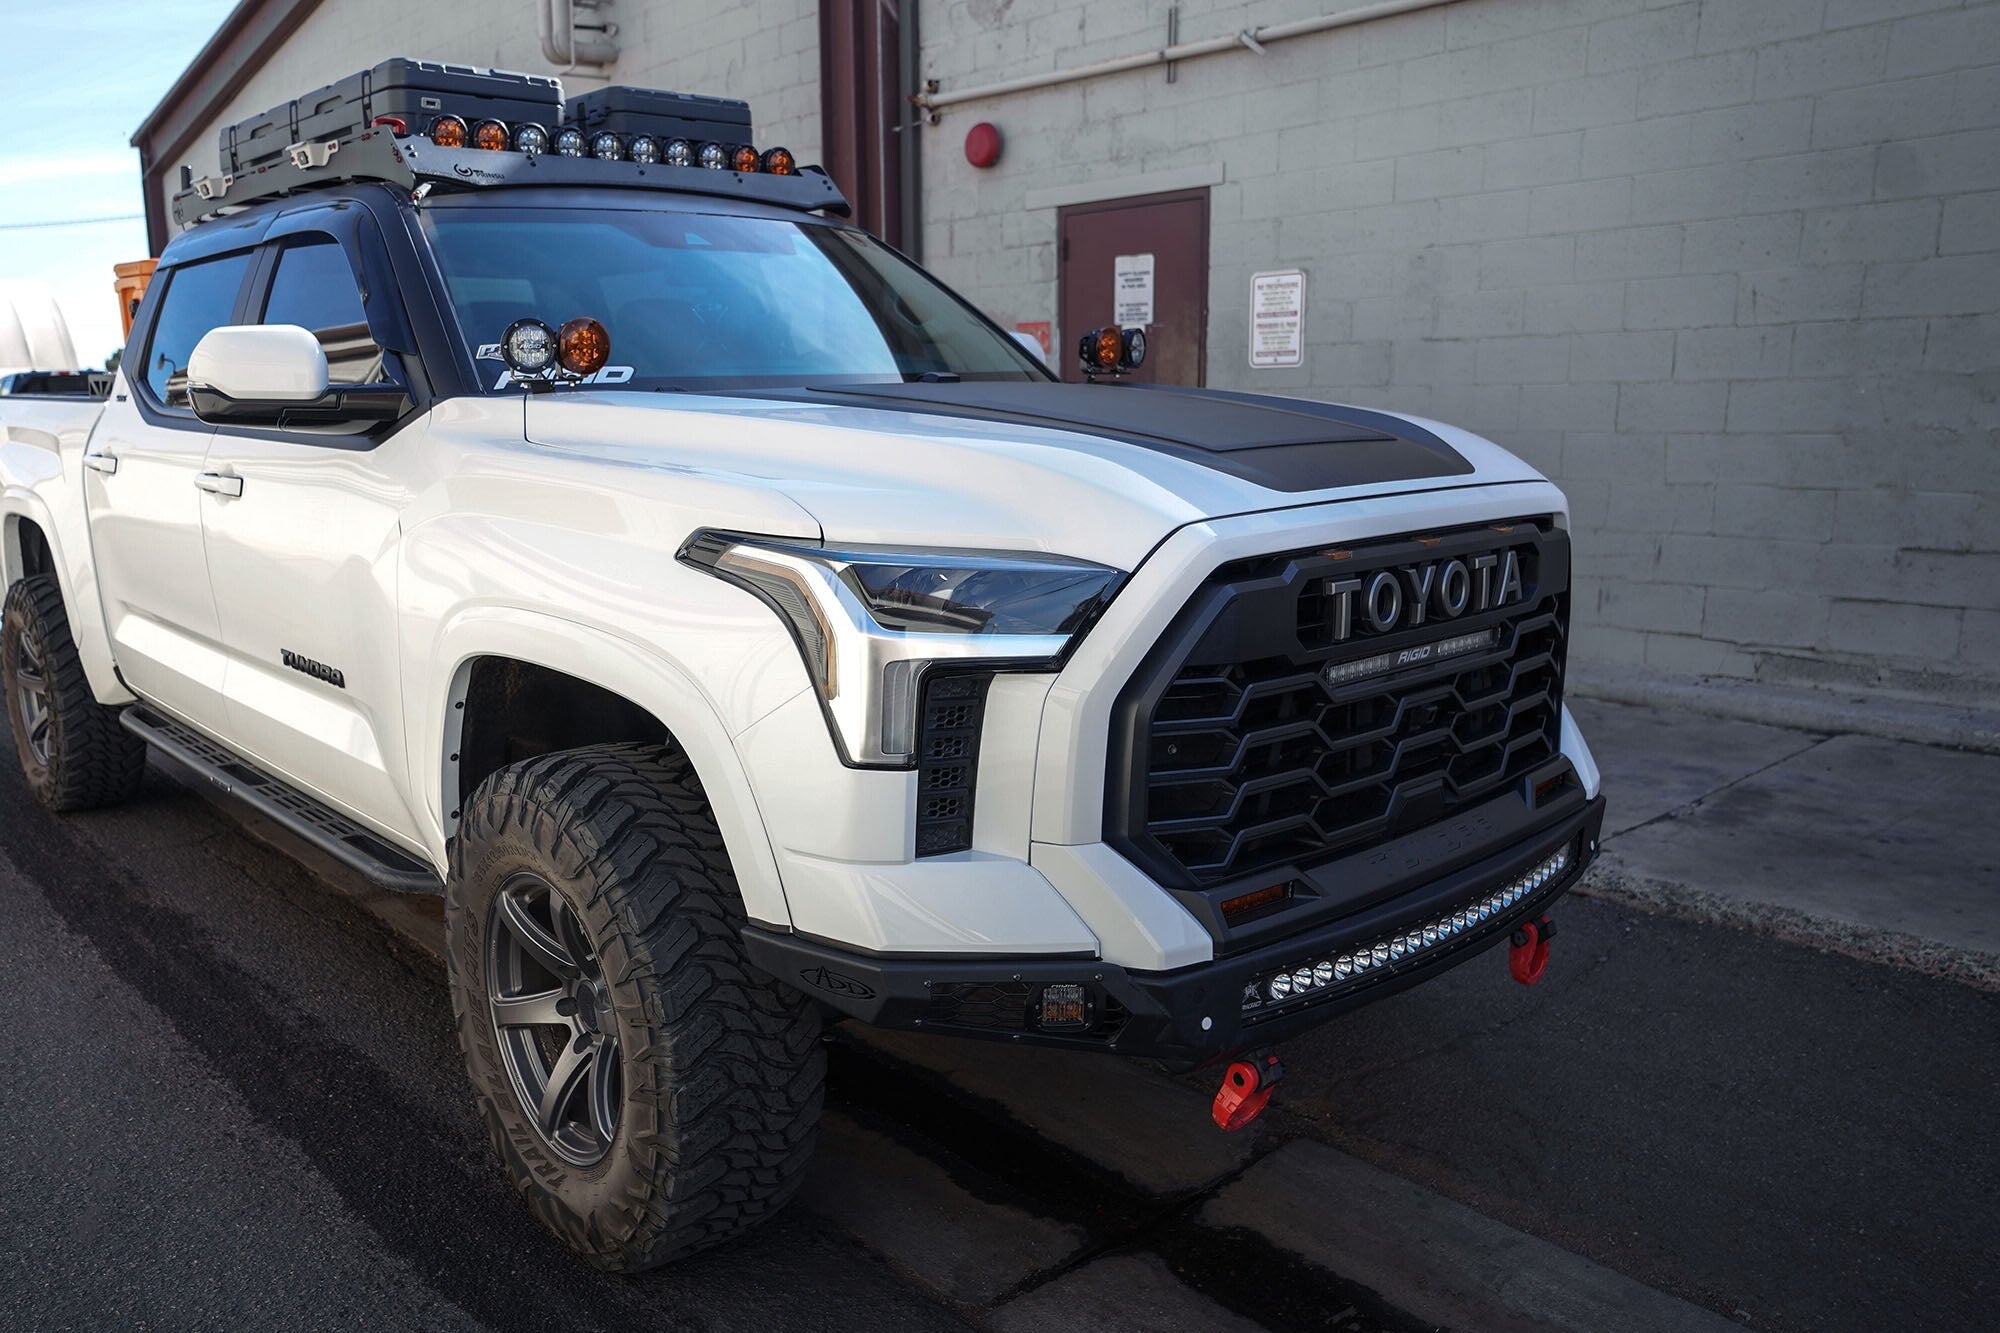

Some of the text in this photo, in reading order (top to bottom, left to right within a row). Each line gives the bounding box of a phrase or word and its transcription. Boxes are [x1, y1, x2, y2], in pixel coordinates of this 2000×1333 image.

[1327, 549, 1523, 641] TOYOTA
[280, 648, 346, 689] TUNDRA
[1397, 645, 1432, 664] RIGID
[465, 988, 568, 1189] TRAIL BLADE
